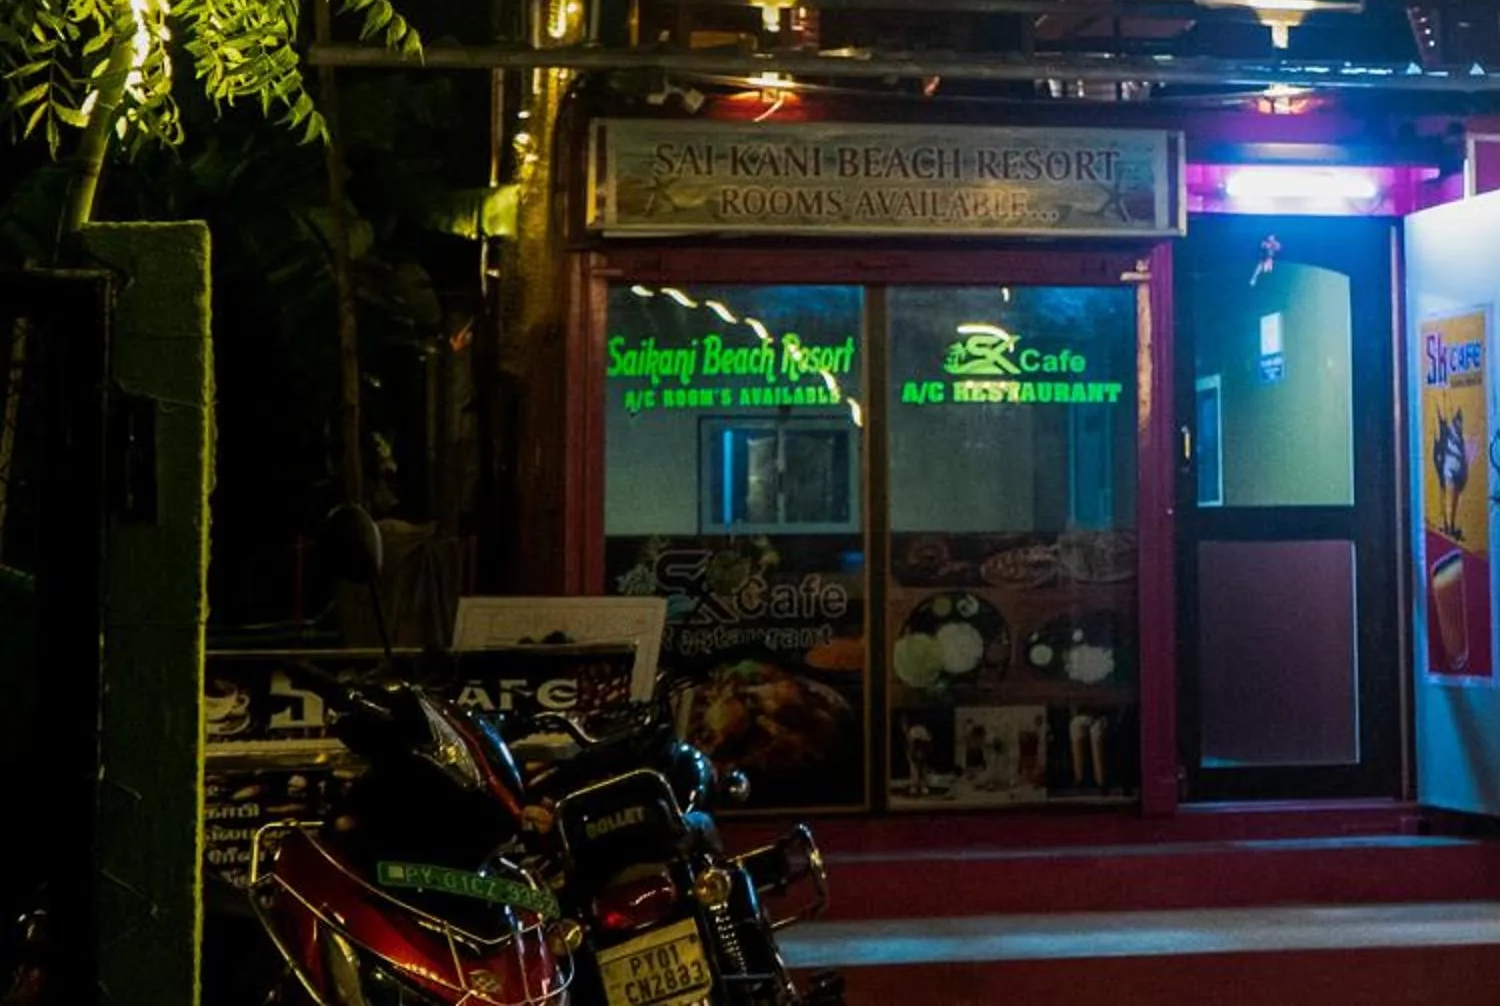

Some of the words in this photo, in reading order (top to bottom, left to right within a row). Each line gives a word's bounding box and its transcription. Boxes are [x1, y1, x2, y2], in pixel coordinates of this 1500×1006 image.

[729, 145, 822, 178] KANI
[838, 146, 961, 180] BEACH
[976, 148, 1120, 181] RESORT
[720, 189, 843, 216] ROOMS
[608, 335, 698, 385] Saikani
[702, 334, 776, 382] Beach
[781, 333, 855, 382] Resort
[1019, 348, 1087, 373] Cafe
[624, 388, 655, 412] A/C
[739, 386, 841, 406] AVAILABLE
[902, 380, 945, 404] A/C
[952, 380, 1122, 403] RESTAURANT
[733, 572, 849, 621] Cafe
[629, 943, 680, 977] PY01
